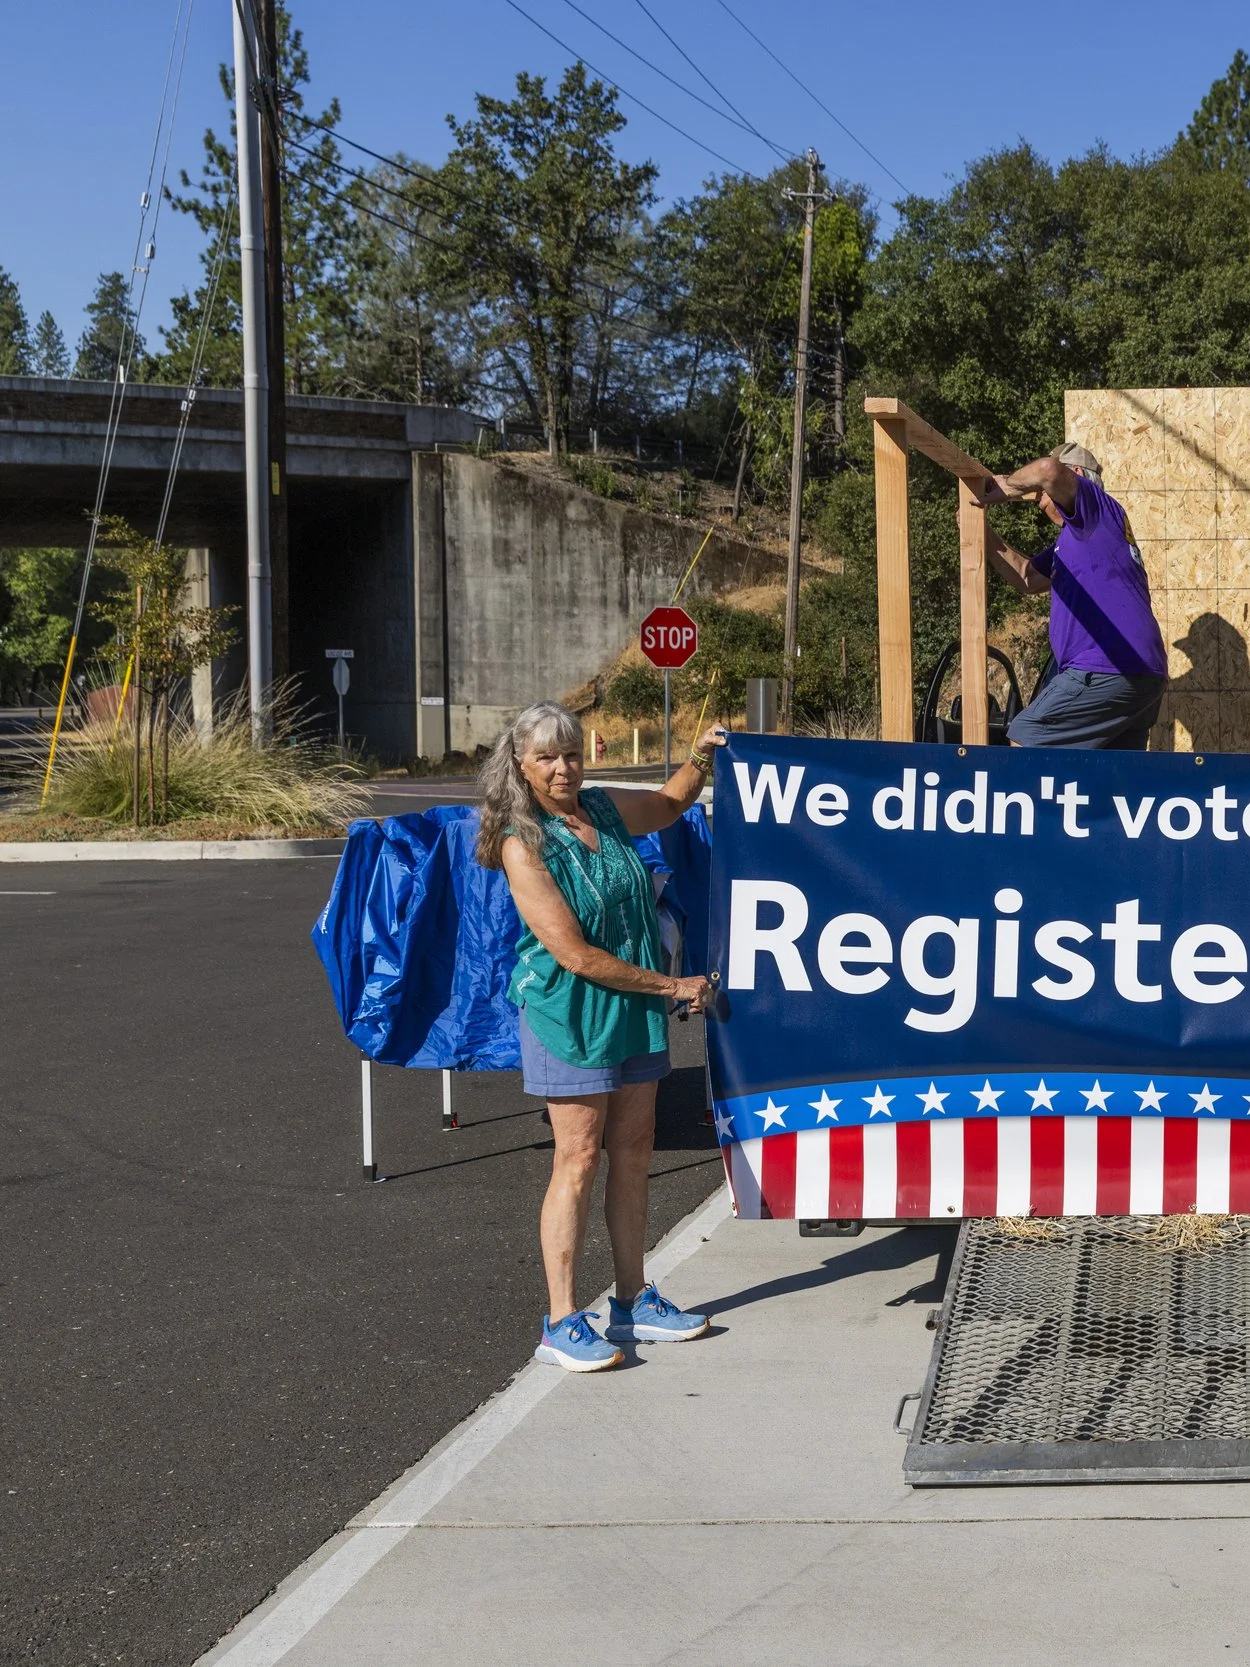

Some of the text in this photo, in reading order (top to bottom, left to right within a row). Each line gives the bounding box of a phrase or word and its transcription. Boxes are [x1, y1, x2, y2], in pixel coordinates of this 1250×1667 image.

[644, 626, 694, 649] STOP
[733, 762, 848, 826] We
[873, 768, 1089, 837] didn't
